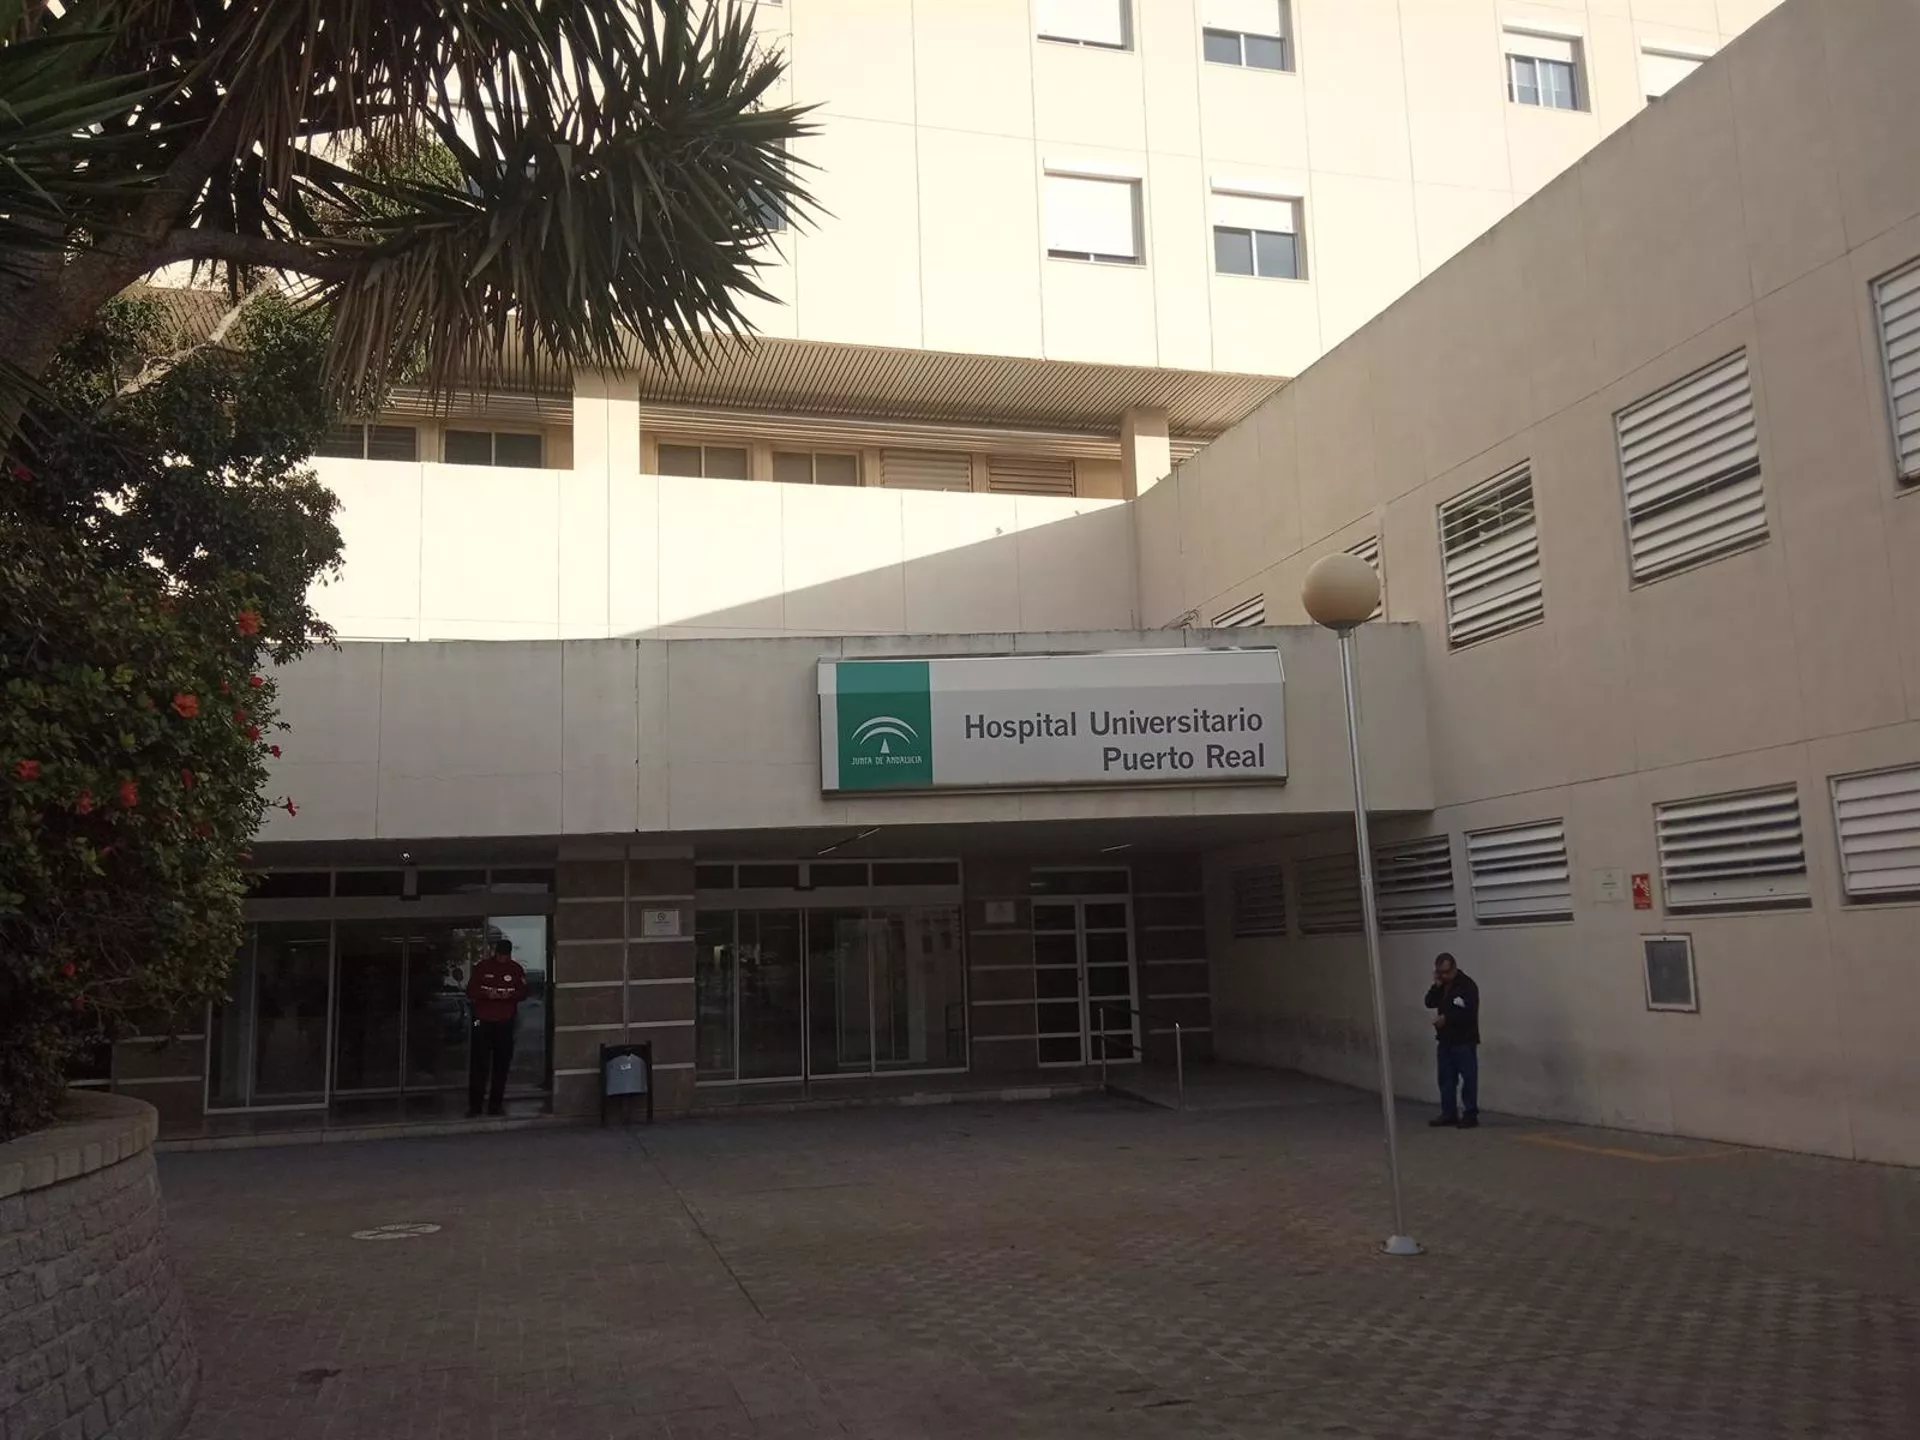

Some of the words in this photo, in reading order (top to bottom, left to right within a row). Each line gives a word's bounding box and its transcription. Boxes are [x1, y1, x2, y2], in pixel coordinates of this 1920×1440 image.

[965, 712, 1076, 744] Hospital
[1090, 708, 1263, 737] Universitario
[852, 757, 872, 766] JUNTA
[1103, 745, 1194, 771] Puerto
[1206, 742, 1266, 768] Real
